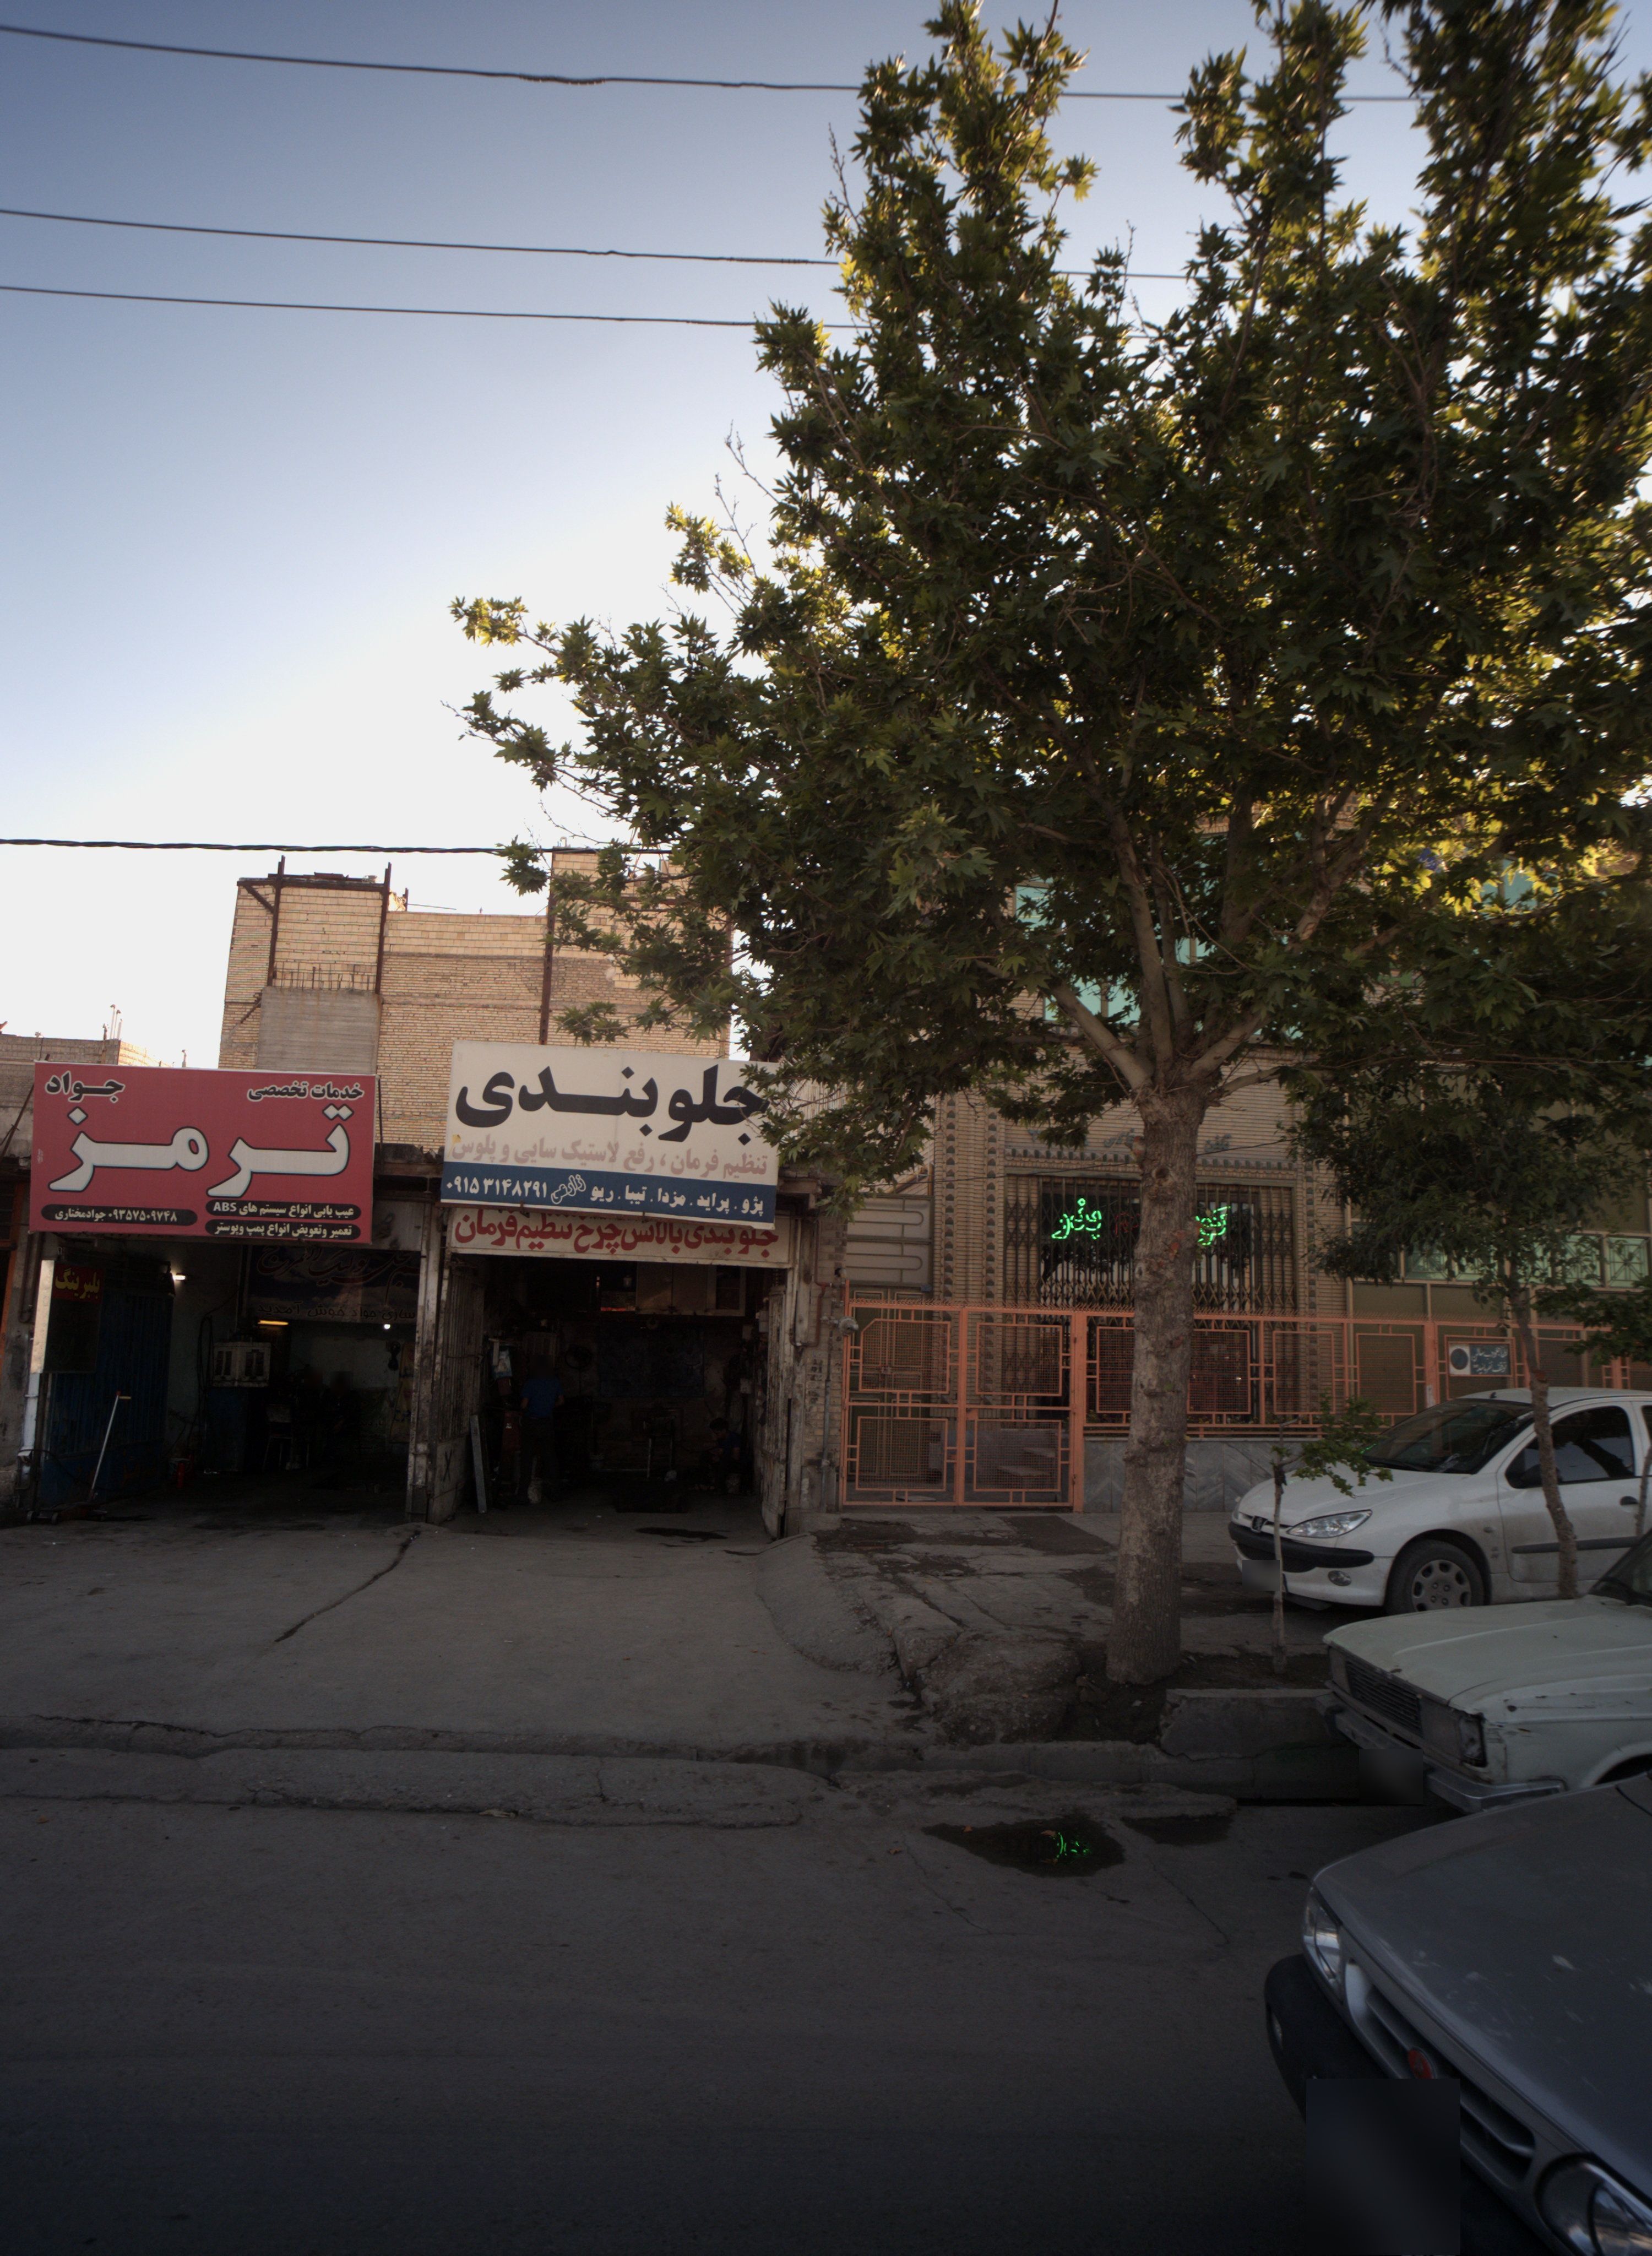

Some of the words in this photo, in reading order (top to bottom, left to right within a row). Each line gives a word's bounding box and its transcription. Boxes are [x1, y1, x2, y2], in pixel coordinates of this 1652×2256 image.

[45, 1070, 126, 1103] جواد
[248, 1080, 309, 1101] تخصصی
[311, 1081, 365, 1100] خدمات
[48, 1103, 354, 1198] ترمز
[452, 1133, 496, 1163] پلوس
[499, 1143, 509, 1163] و
[514, 1136, 557, 1164] سایی
[562, 1140, 620, 1167] لاستیک
[623, 1142, 654, 1172] رفع
[724, 1153, 768, 1179] تنظیم
[590, 1185, 614, 1202] ریو
[625, 1185, 647, 1205] تیبا
[657, 1188, 686, 1208] مزدا
[697, 1192, 730, 1214] پراید
[213, 1202, 237, 1212] ABS
[238, 1202, 258, 1216] های
[259, 1203, 287, 1216] سیستم
[288, 1204, 312, 1218] انواع
[313, 1205, 333, 1218] یابی
[335, 1207, 354, 1219] عیب
[741, 1196, 764, 1216] پژو
[246, 1224, 265, 1237] پمپ
[267, 1223, 290, 1237] انواع
[329, 1225, 352, 1238] تعمیر
[455, 1208, 518, 1247] فرمان
